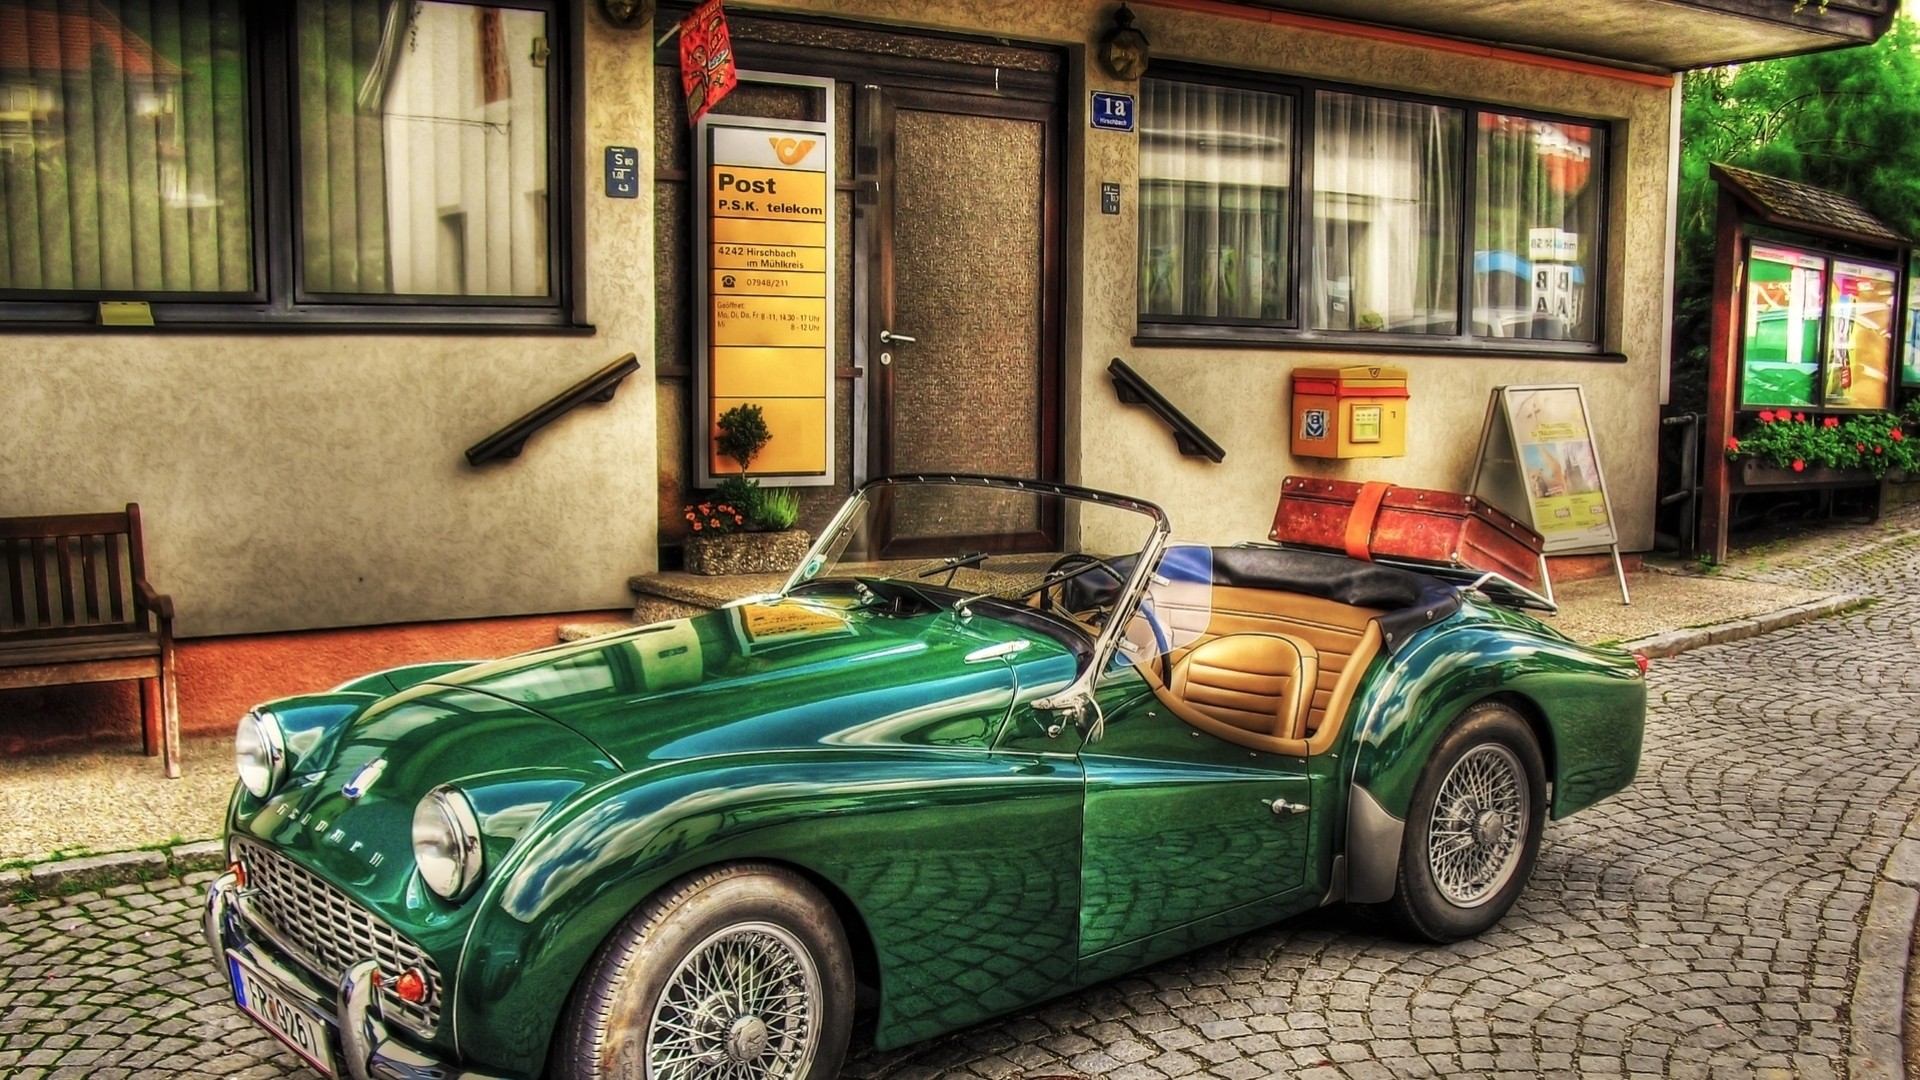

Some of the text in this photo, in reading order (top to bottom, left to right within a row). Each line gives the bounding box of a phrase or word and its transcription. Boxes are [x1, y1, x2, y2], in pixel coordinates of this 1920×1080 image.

[1104, 98, 1126, 116] 1a
[1099, 117, 1127, 126] Hirschbach
[615, 153, 623, 165] S
[718, 173, 776, 194] Post
[718, 200, 822, 215] P.S.K. telekom
[718, 246, 797, 258] 4242 Hirschbach
[760, 259, 804, 269] Mühlkreis
[746, 279, 788, 288] 07948/211
[800, 314, 807, 322] 17
[800, 323, 807, 331] 12
[808, 323, 820, 331] Uhr
[247, 976, 270, 1021] FR
